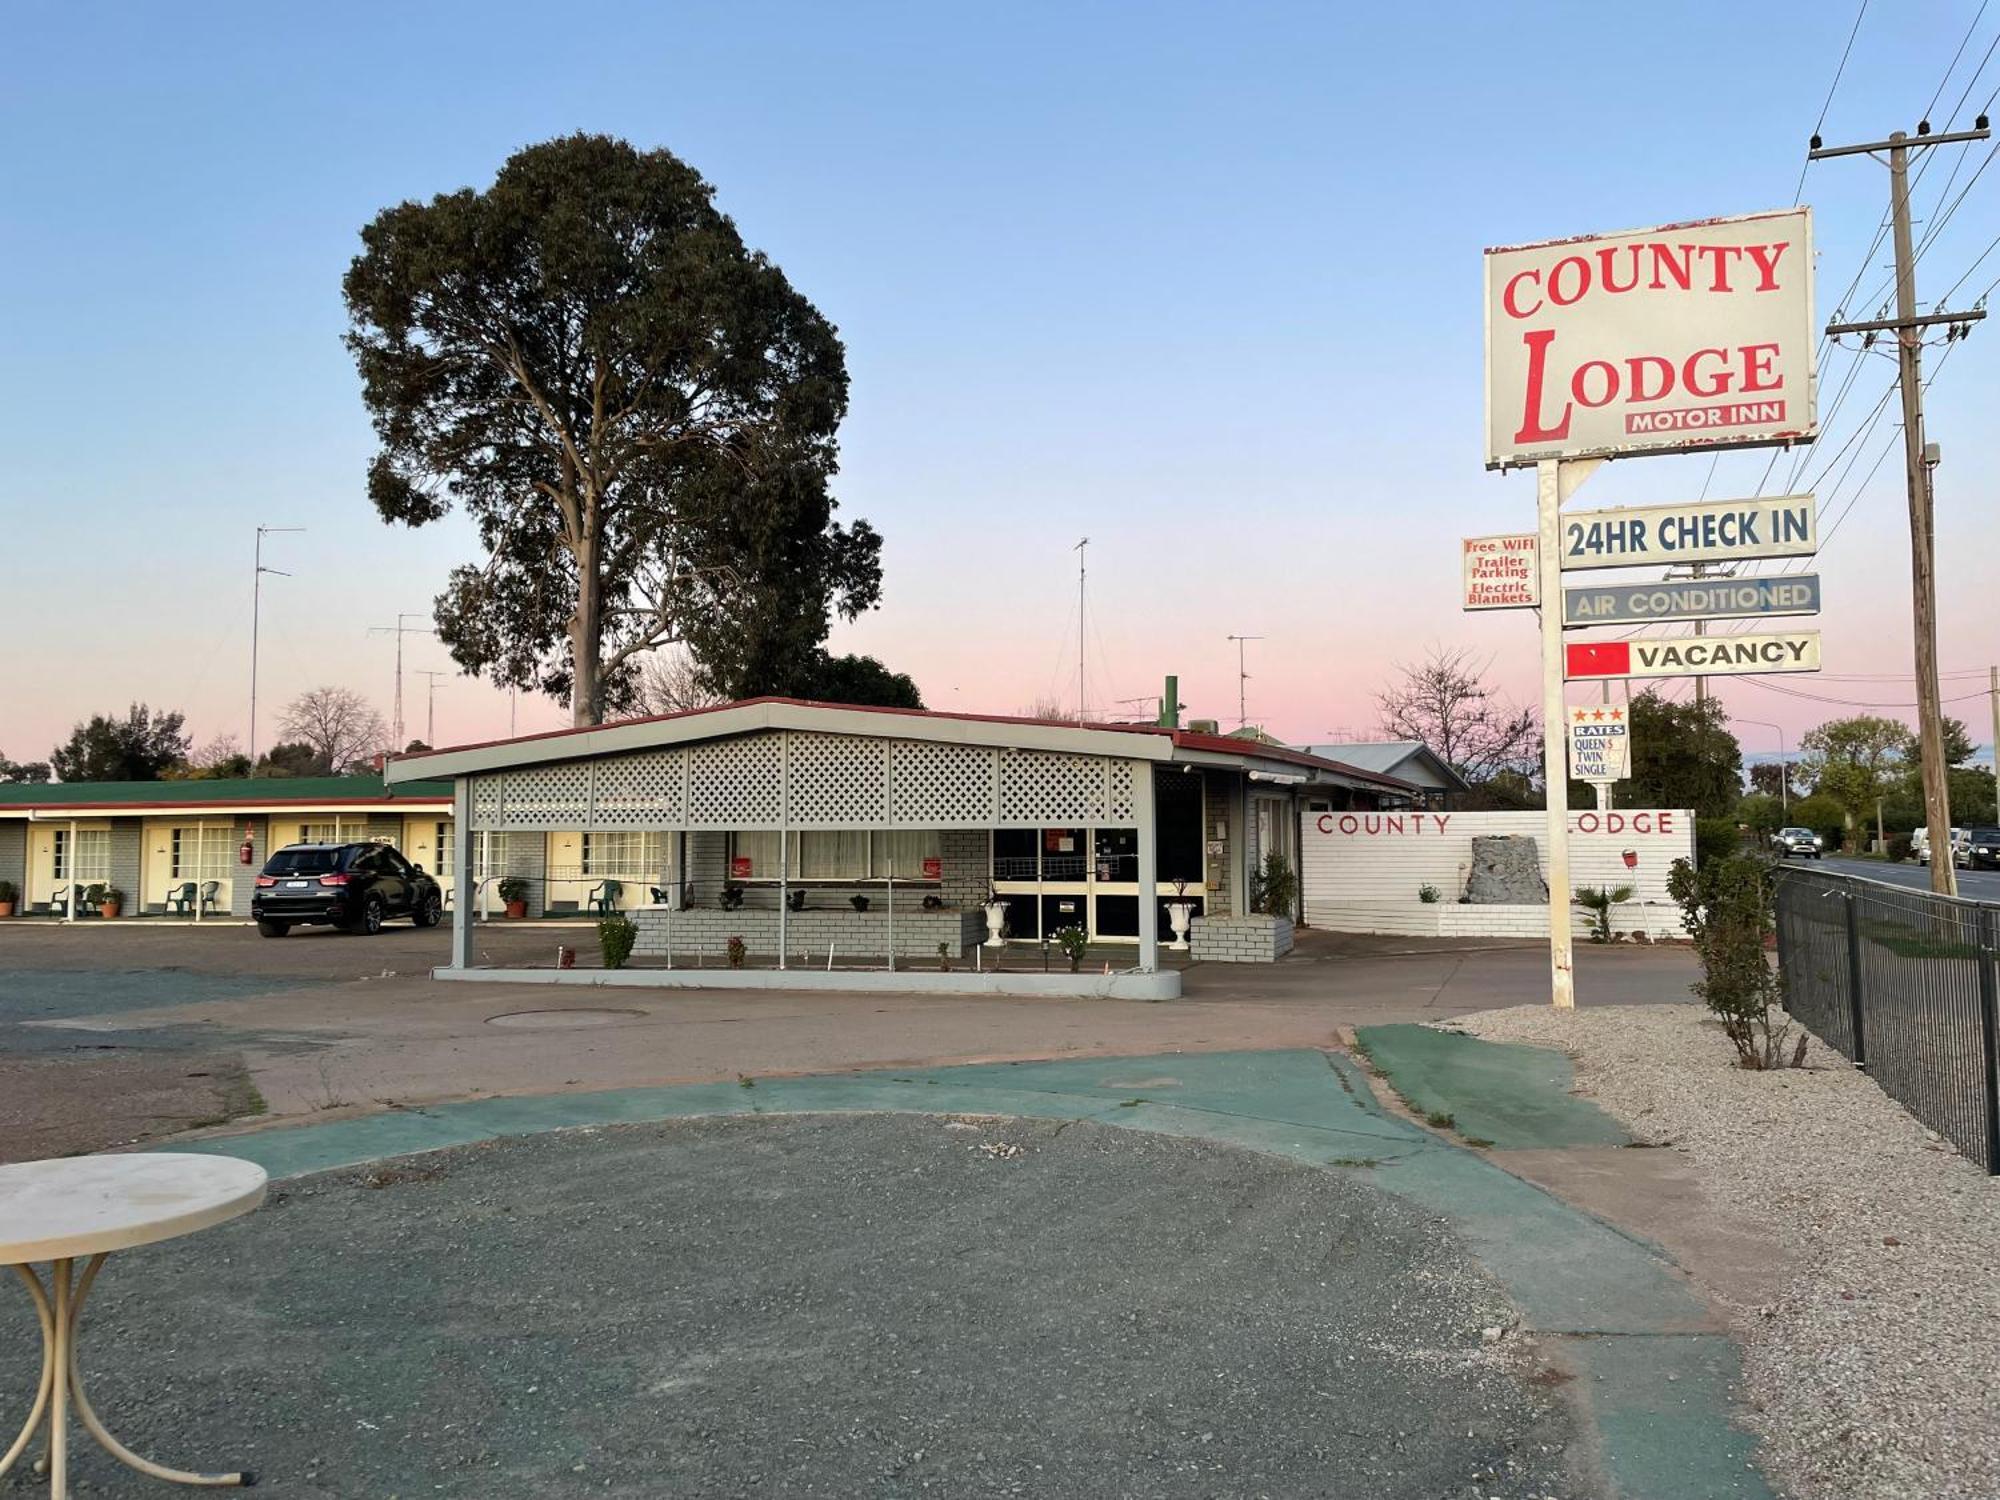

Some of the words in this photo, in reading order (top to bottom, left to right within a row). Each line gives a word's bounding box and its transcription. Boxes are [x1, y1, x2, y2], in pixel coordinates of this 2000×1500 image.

[1503, 242, 1789, 318] COUNTY
[1514, 329, 1784, 444] LODGE
[1631, 407, 1722, 433] MOTOR
[1731, 401, 1780, 424] INN
[1567, 520, 1648, 556] 24HR
[1658, 511, 1760, 551] CHECK
[1772, 507, 1808, 543] IN
[1466, 540, 1496, 552] Free
[1476, 556, 1524, 568] Trailer
[1472, 567, 1528, 579] Parking
[1472, 581, 1528, 593] Electric
[1468, 593, 1532, 604] Blankets
[1575, 595, 1616, 616] AIR
[1628, 584, 1812, 613] CONDITIONED
[1638, 641, 1809, 667] VACANCY
[1575, 726, 1624, 735] RATES
[1575, 738, 1605, 751] QUEEN
[1577, 751, 1603, 763] TWIN
[1575, 764, 1607, 776] SINGLE
[1317, 814, 1451, 835] COUNTY
[1567, 812, 1673, 834] ODGE
